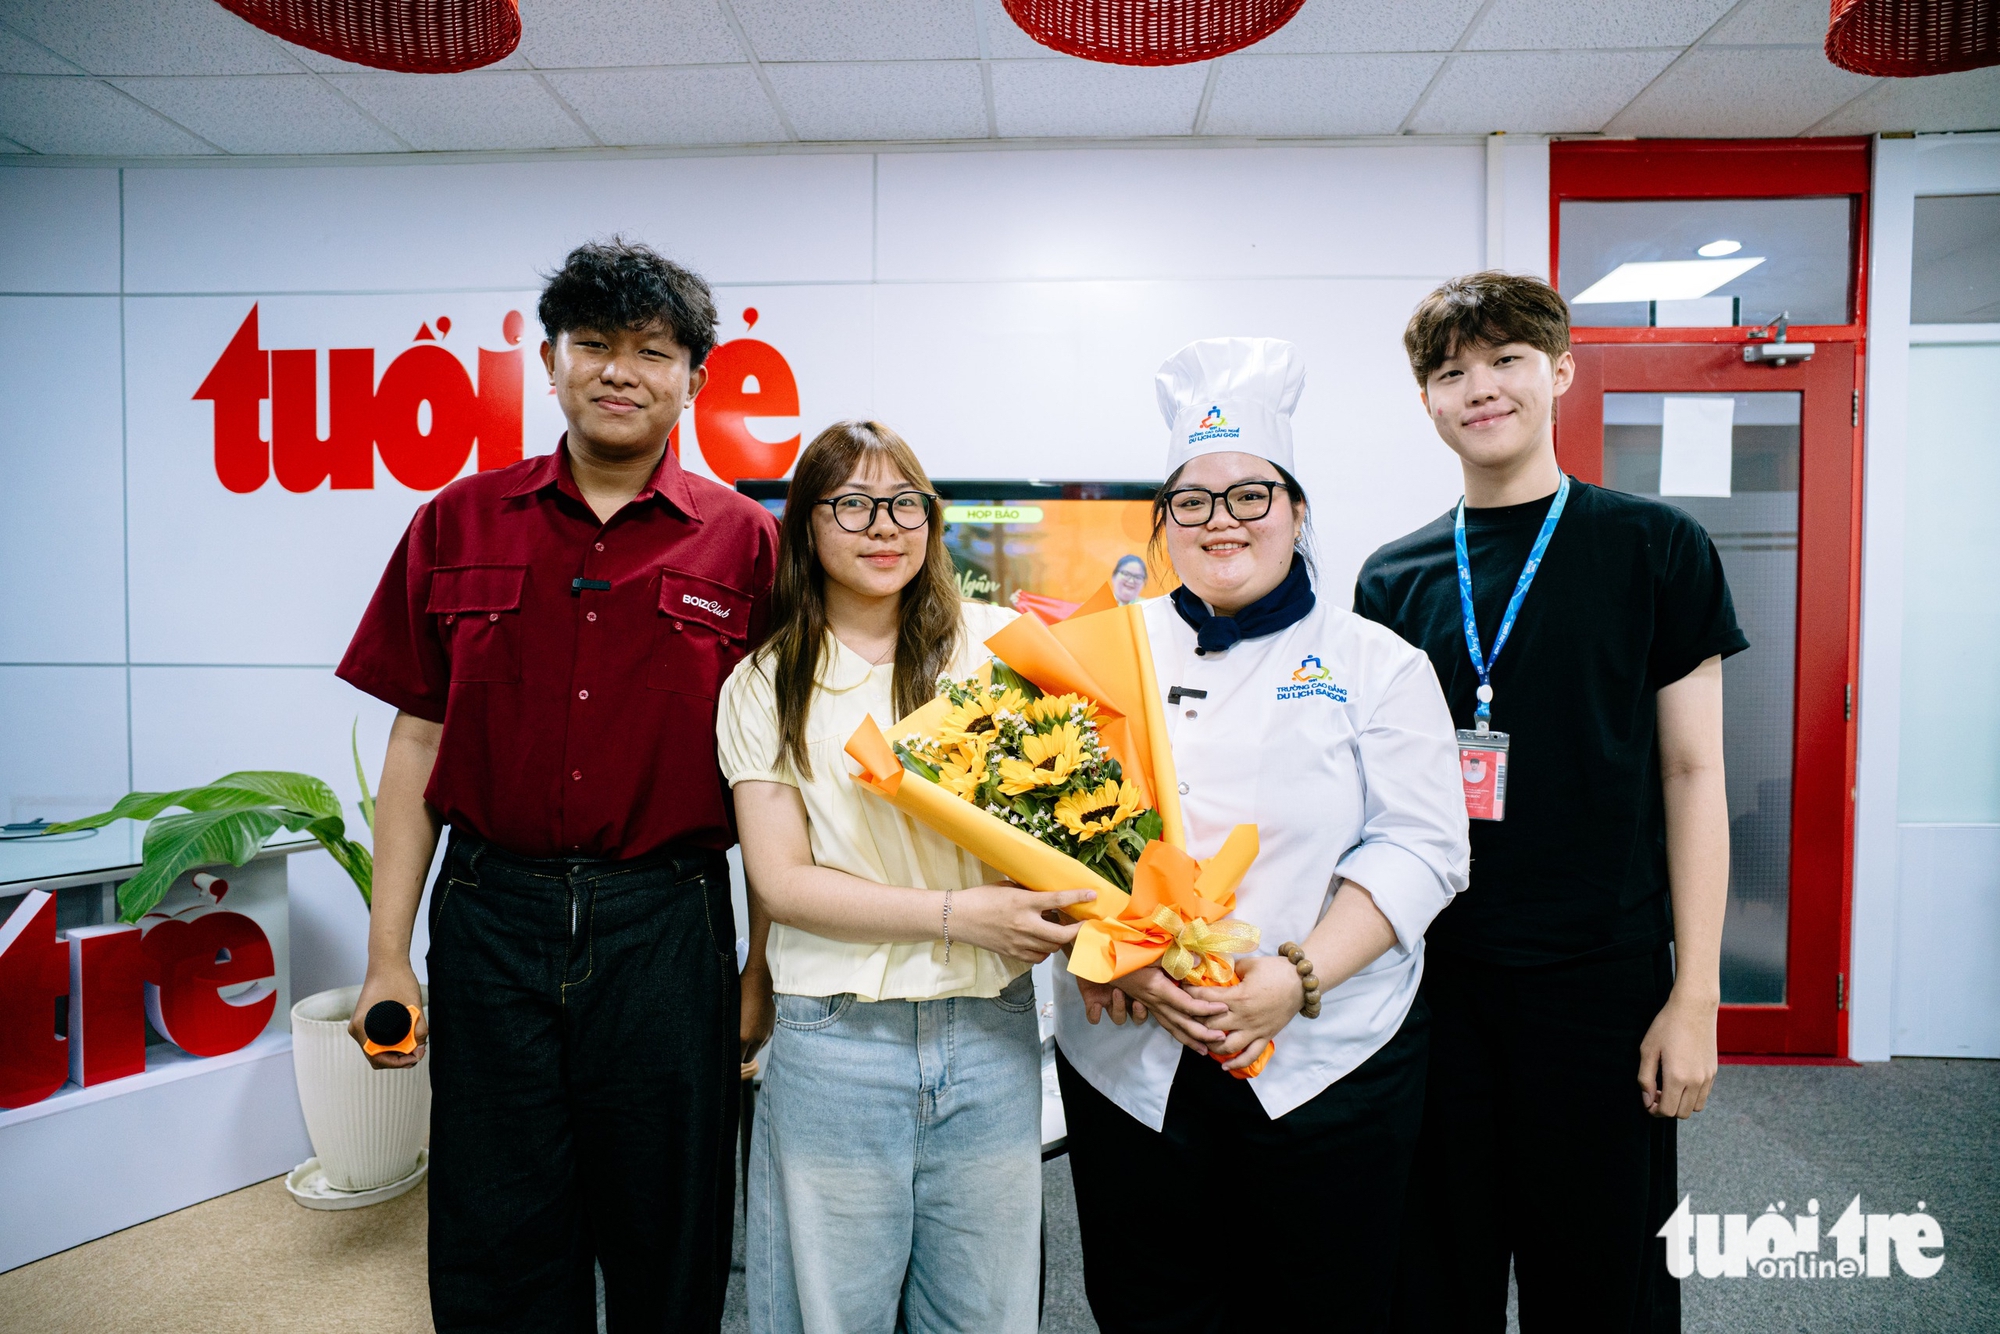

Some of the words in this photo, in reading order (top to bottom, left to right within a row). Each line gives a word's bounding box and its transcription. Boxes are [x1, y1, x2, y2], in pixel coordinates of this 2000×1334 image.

[191, 300, 525, 494] tuổi
[954, 569, 1001, 598] Ngân
[1276, 692, 1291, 700] DU
